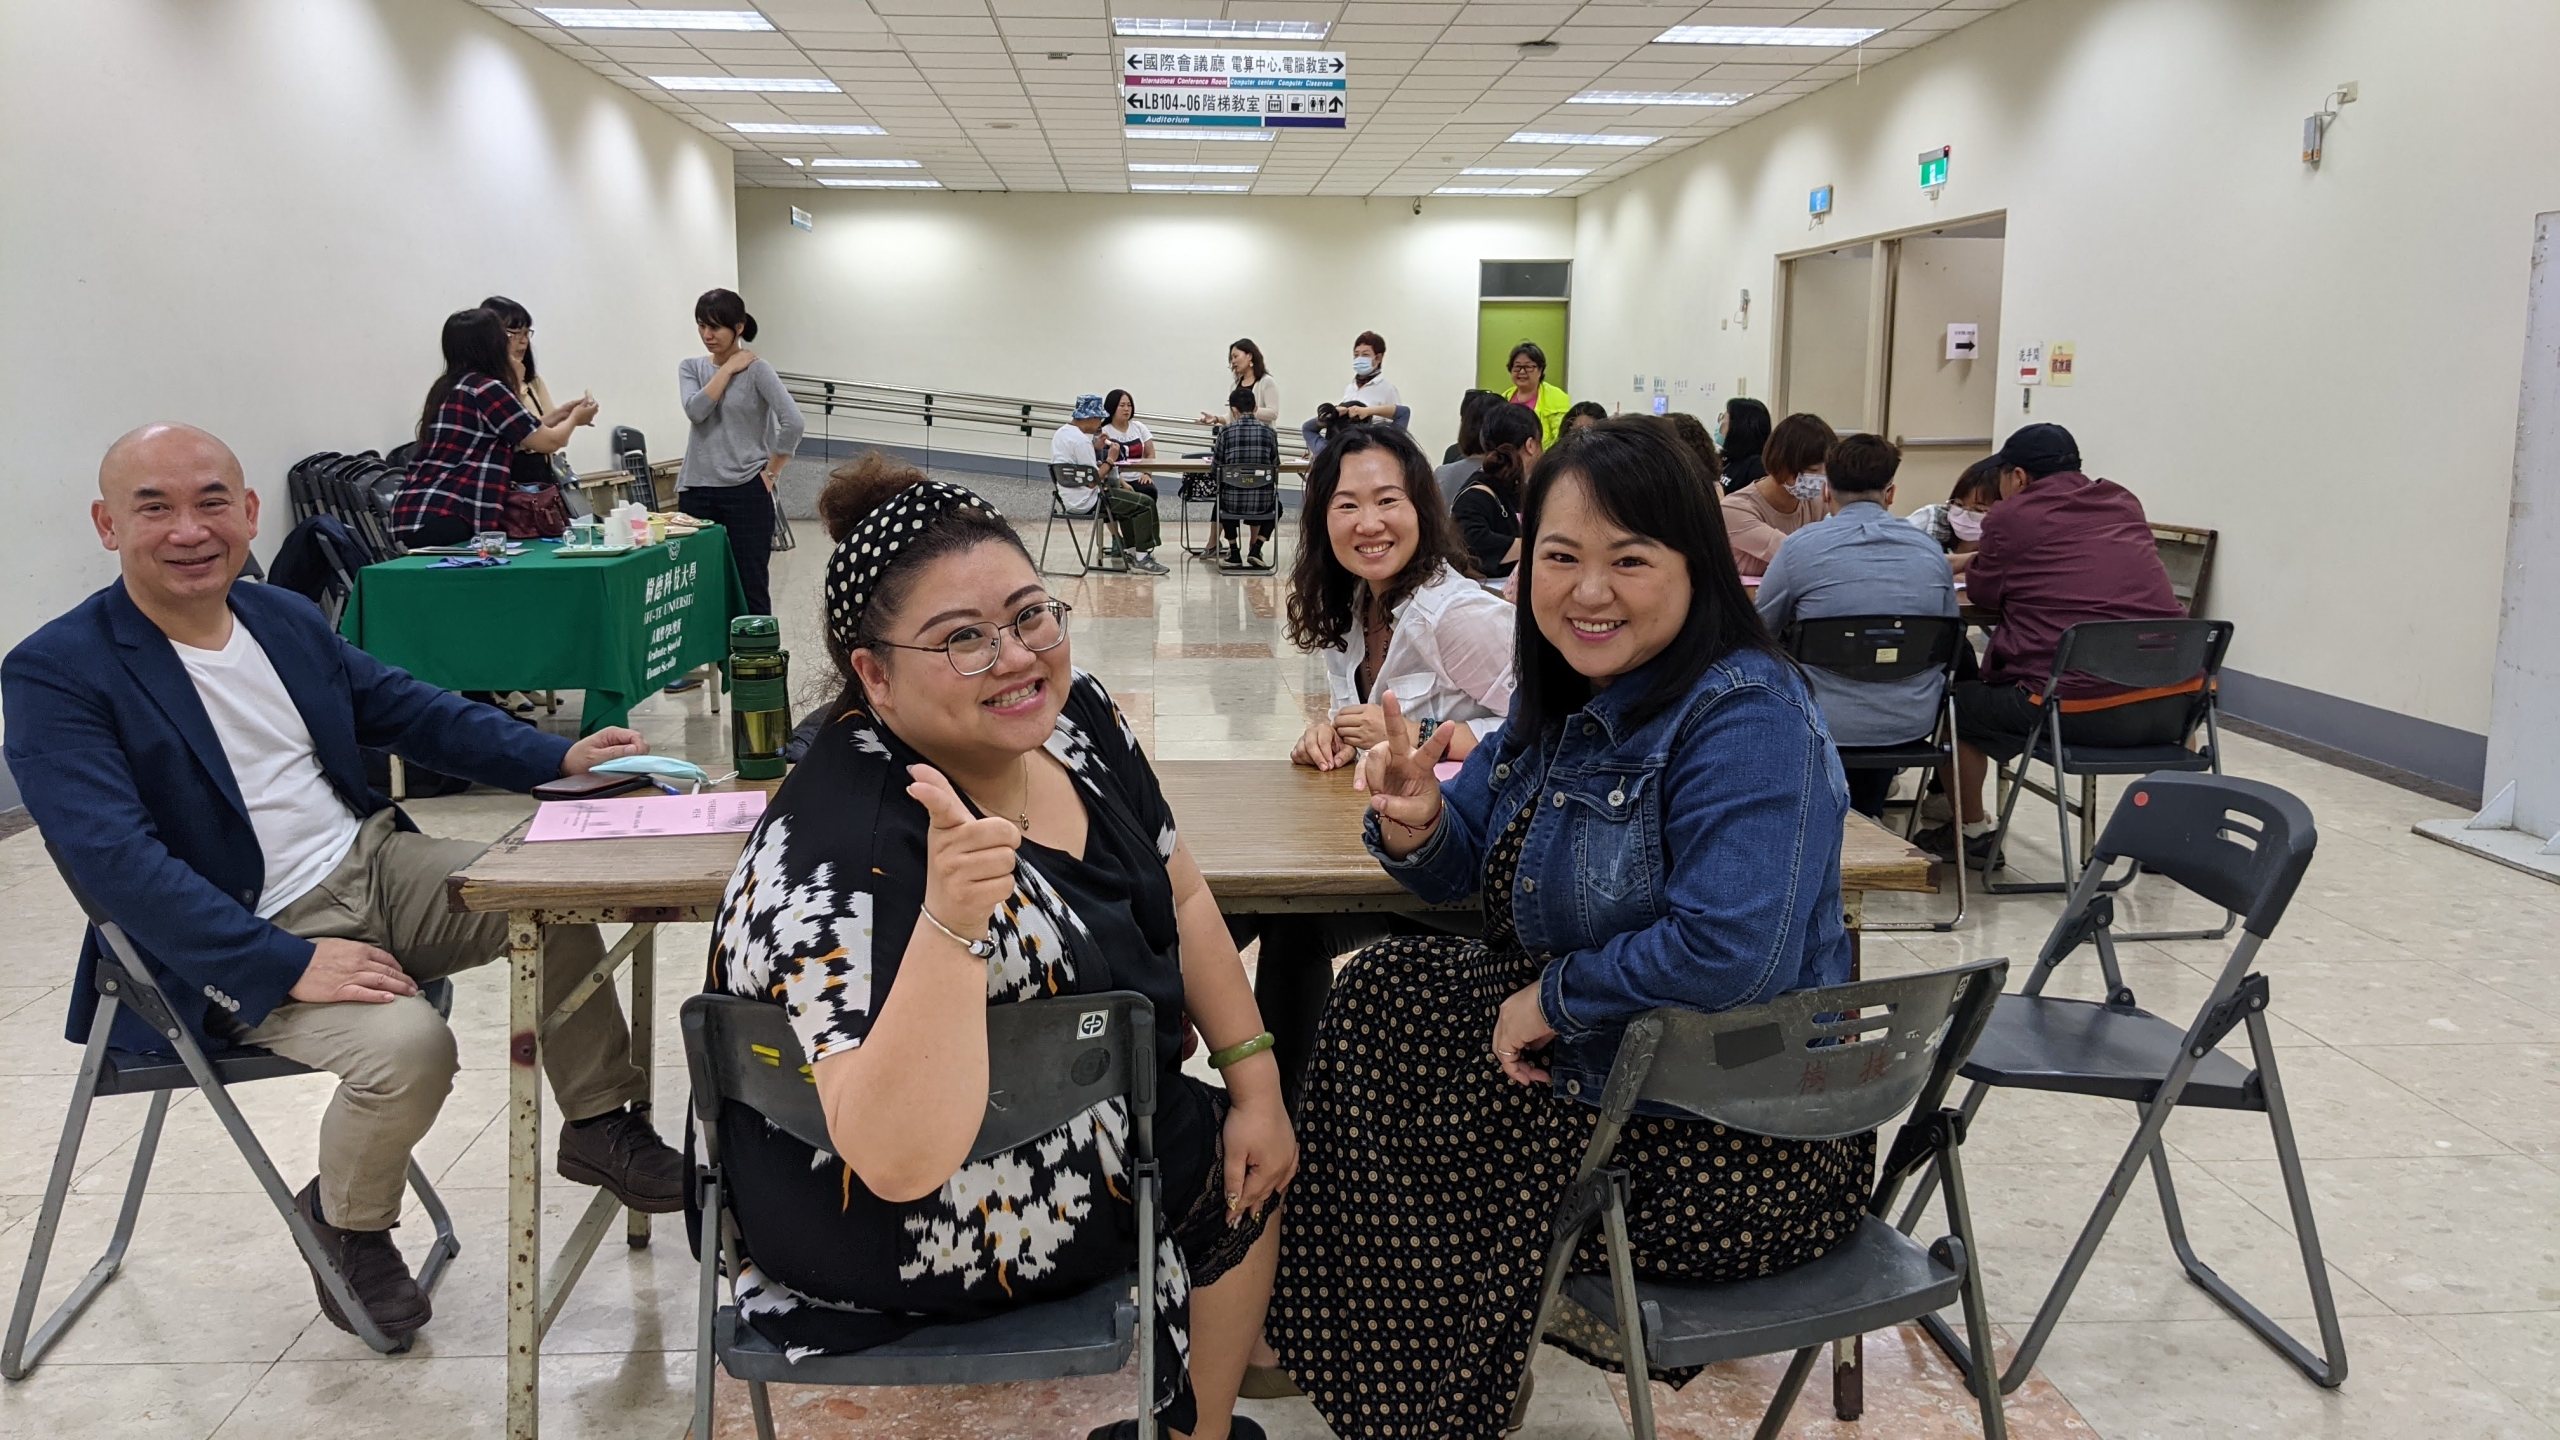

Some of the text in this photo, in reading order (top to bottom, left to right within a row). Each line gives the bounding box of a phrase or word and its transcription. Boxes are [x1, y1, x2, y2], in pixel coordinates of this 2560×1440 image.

[1143, 53, 1226, 72] 國際會議廳
[1140, 77, 1227, 86] International Conference Room
[1230, 78, 1334, 88] Computer center Computer Classroom
[1145, 115, 1190, 124] Auditorium
